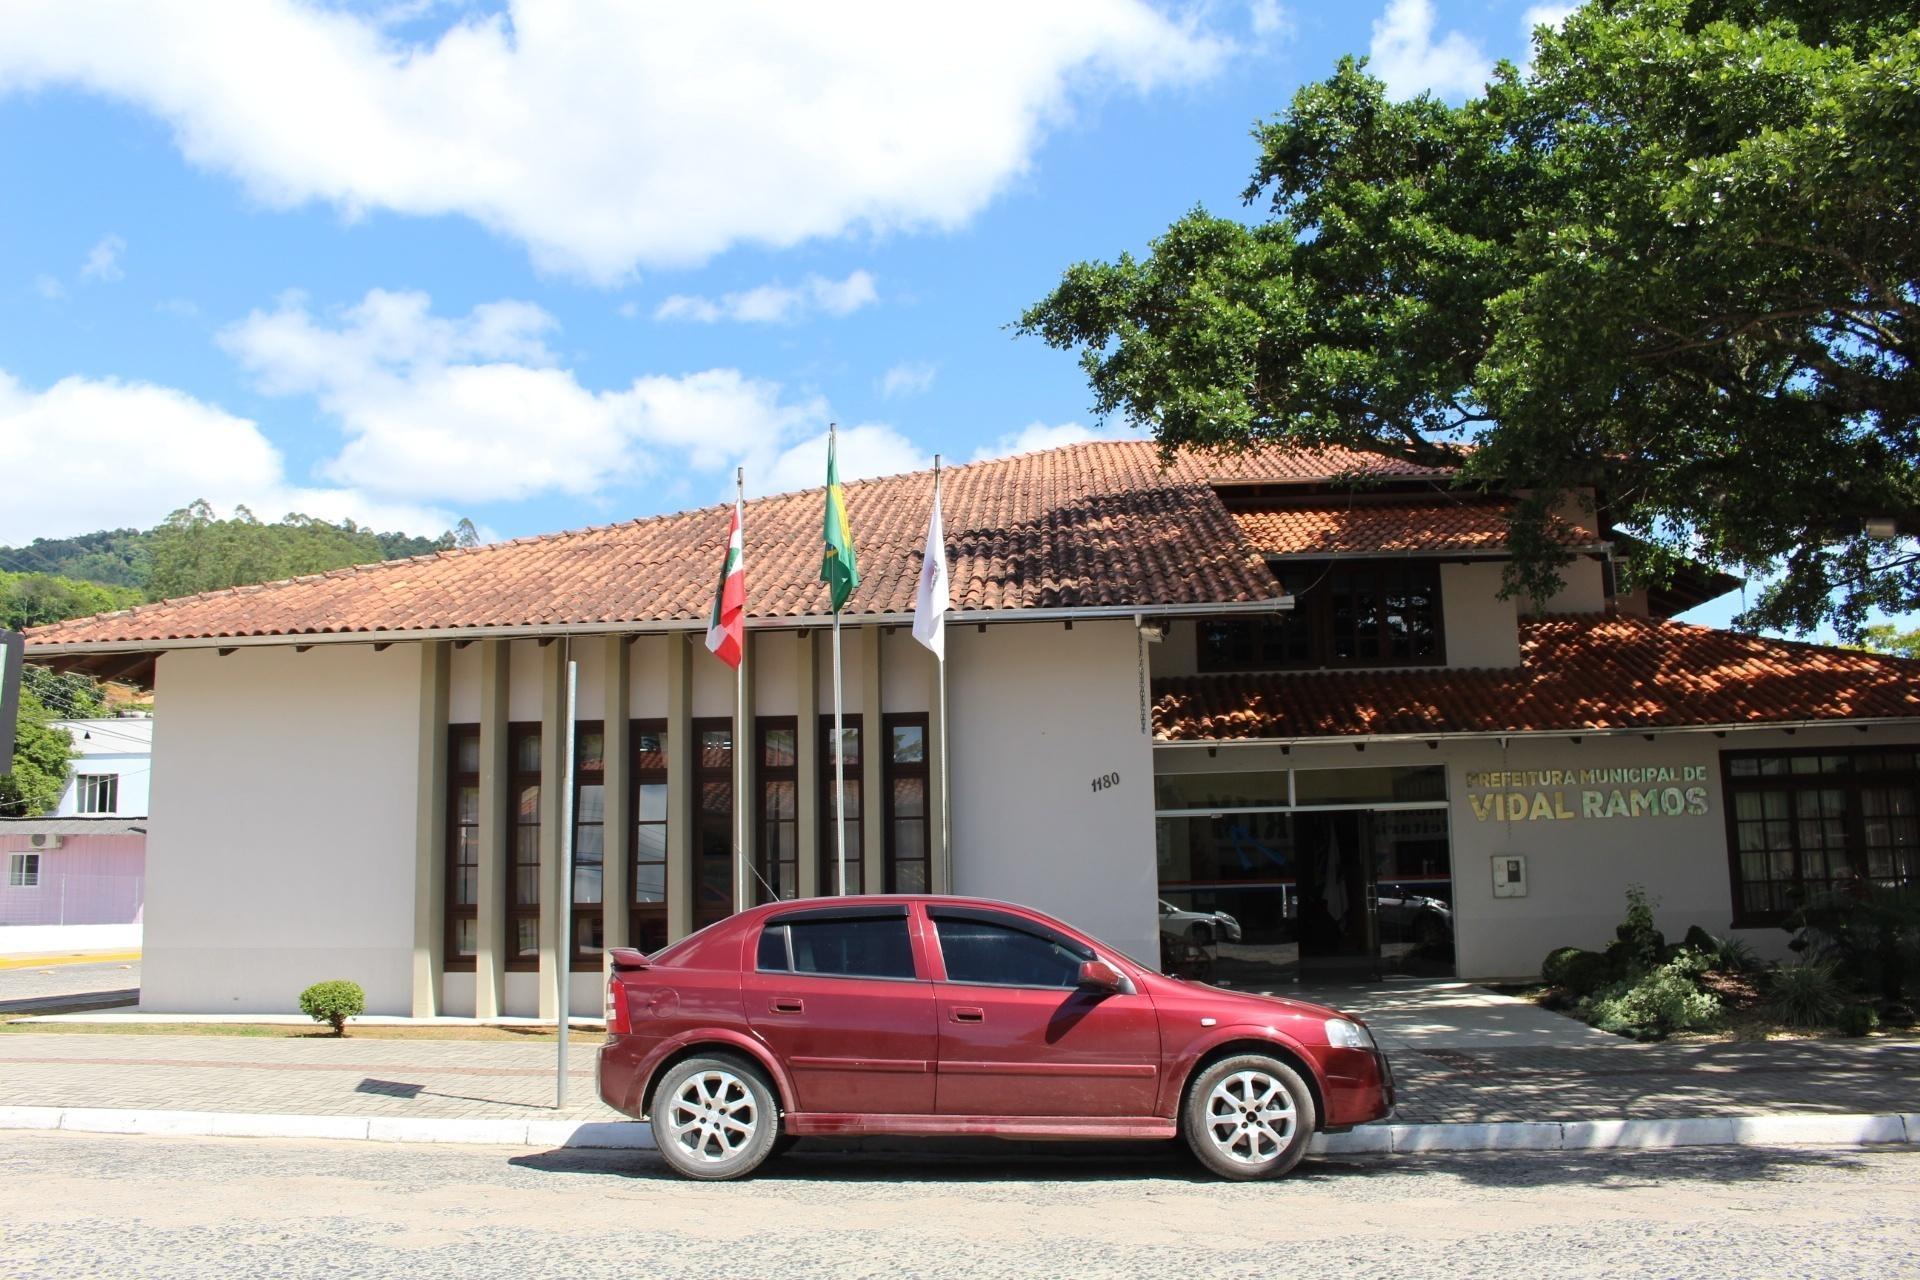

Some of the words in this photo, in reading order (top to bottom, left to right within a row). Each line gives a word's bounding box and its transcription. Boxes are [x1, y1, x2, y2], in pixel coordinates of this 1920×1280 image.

[1091, 772, 1119, 792] 1180
[1579, 767, 1680, 784] MUNICIPAL
[1683, 765, 1707, 782] DE
[1468, 791, 1575, 821] VIDAL
[1582, 786, 1709, 818] RAMOS
